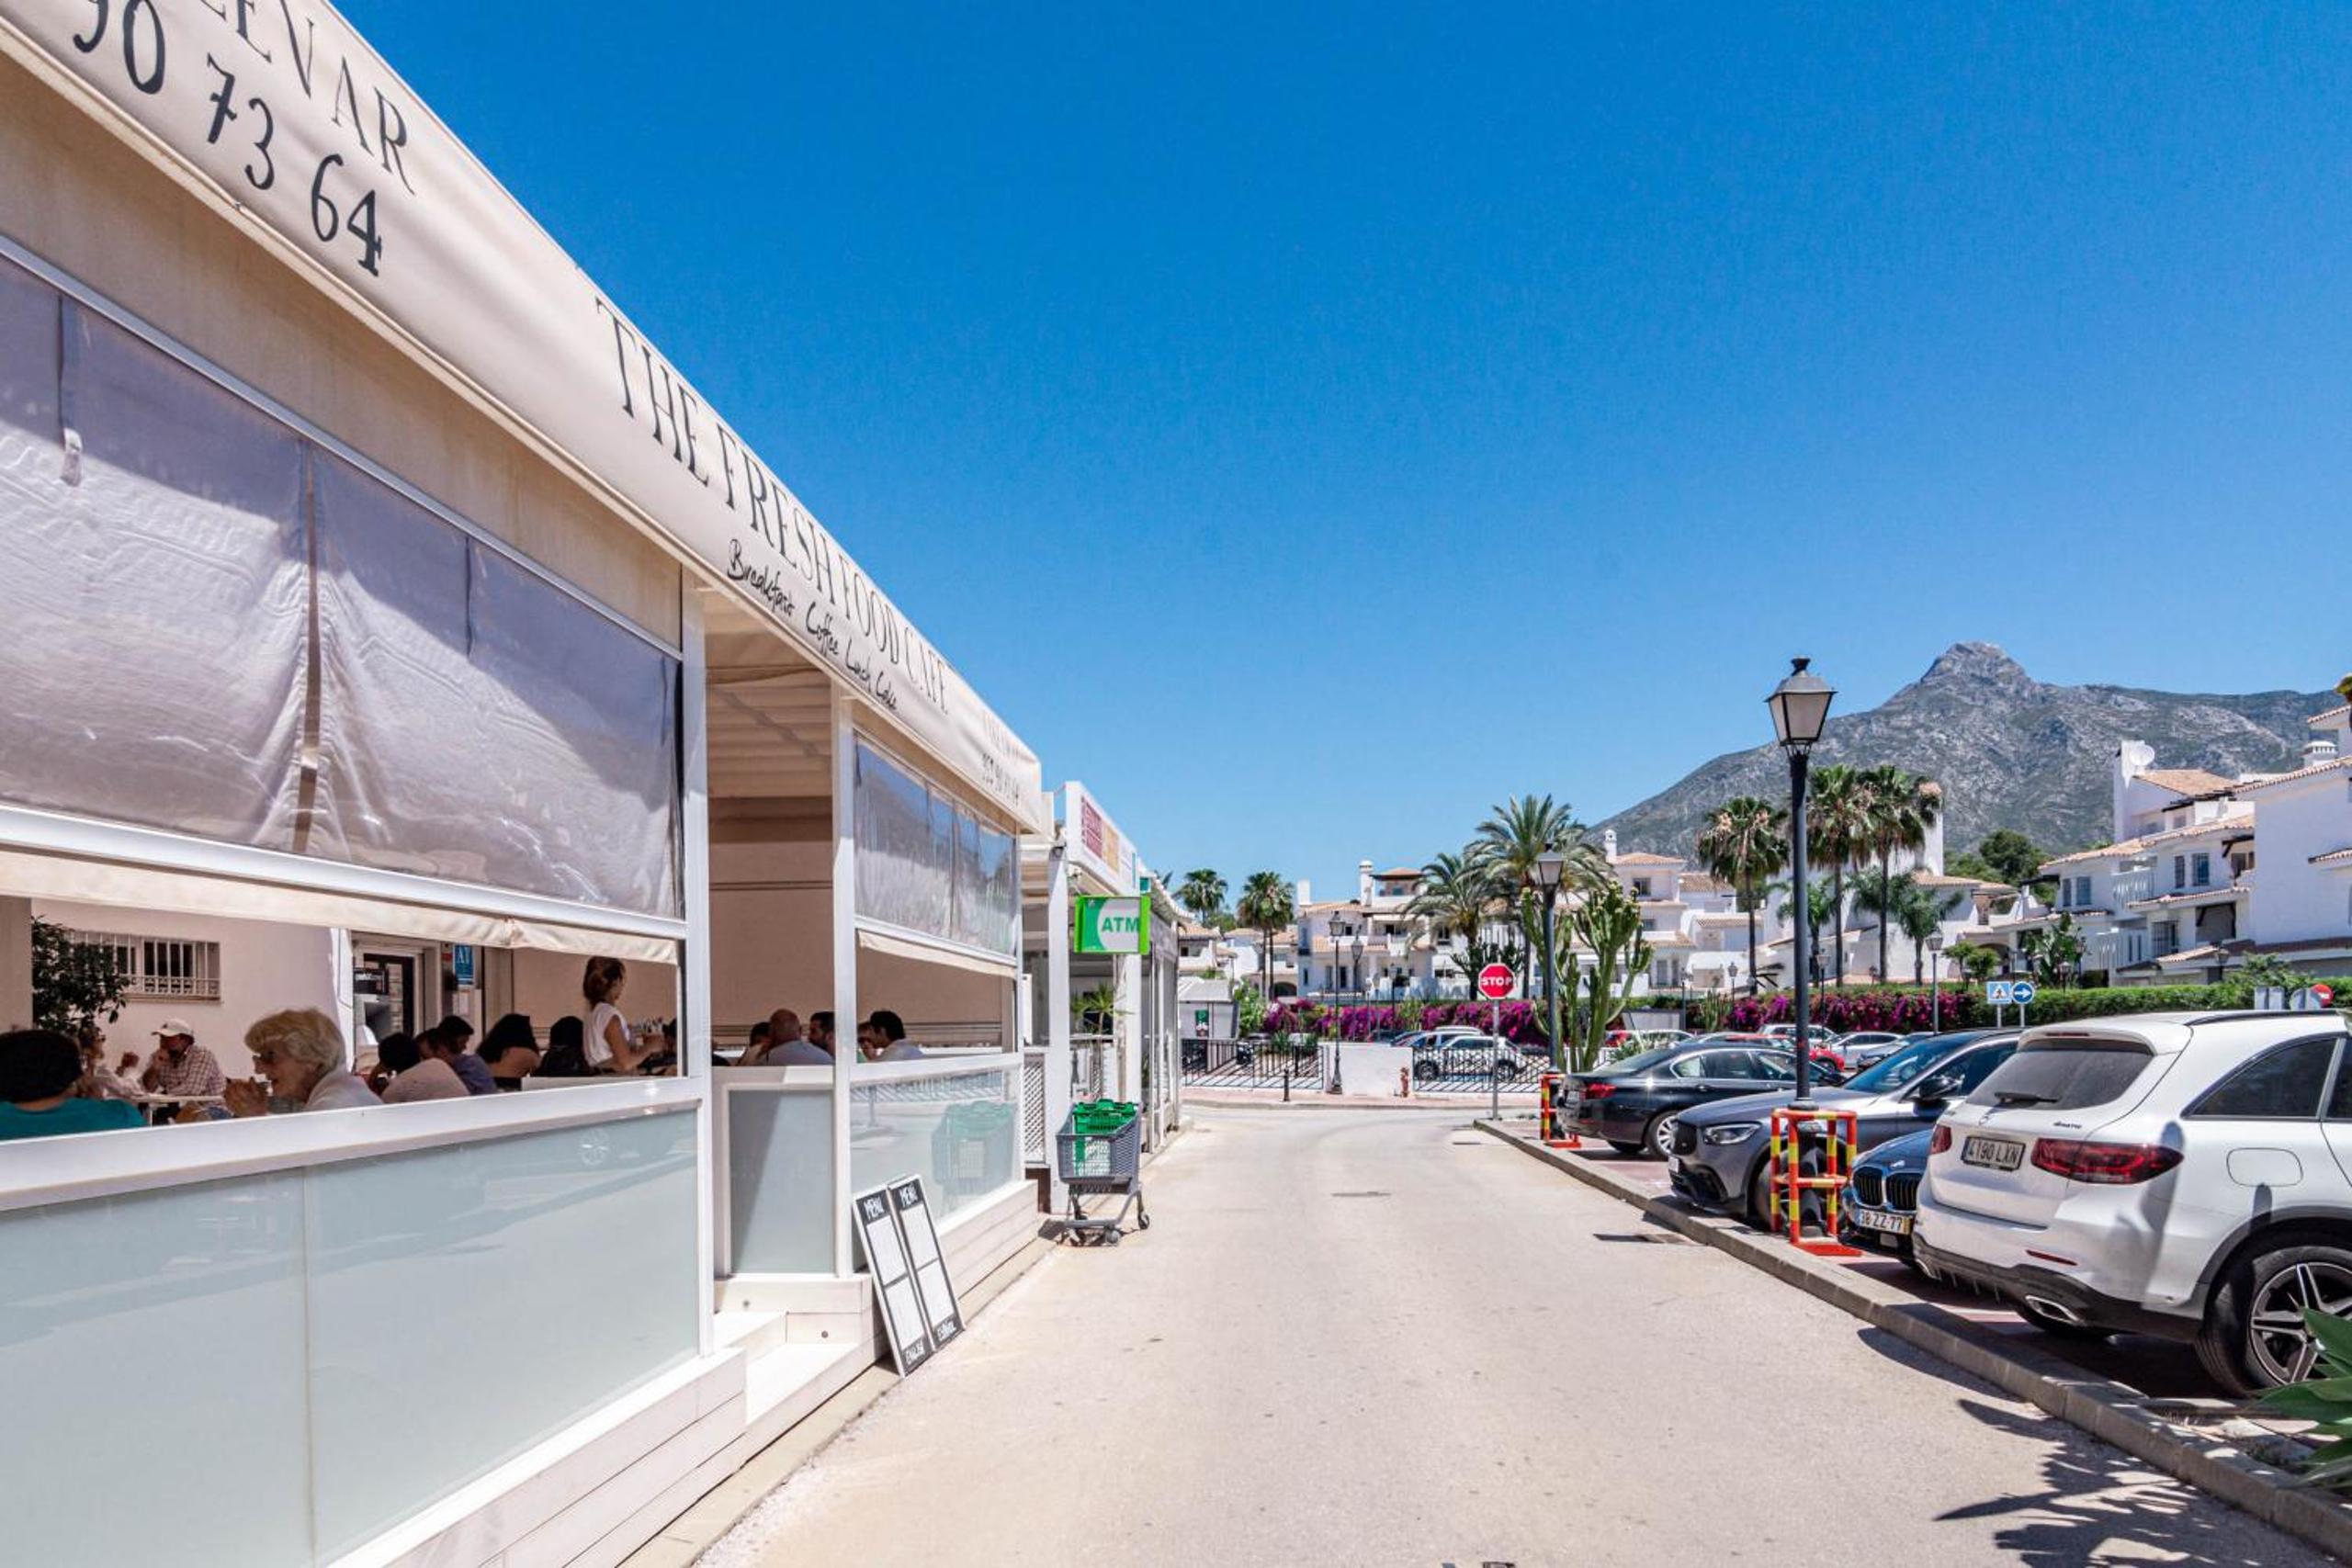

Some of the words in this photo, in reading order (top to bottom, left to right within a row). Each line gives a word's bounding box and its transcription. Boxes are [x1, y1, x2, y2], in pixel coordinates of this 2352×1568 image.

[201, 0, 416, 196] EVAR
[205, 52, 275, 190] 73
[311, 153, 382, 276] 64
[594, 297, 710, 488] THE
[717, 422, 837, 605] FRESH
[838, 553, 900, 665] FOOD
[1102, 917, 1140, 932] ATM
[1481, 976, 1512, 987] STOP
[1967, 1139, 1995, 1163] 4190
[1996, 1143, 2019, 1164] LXN
